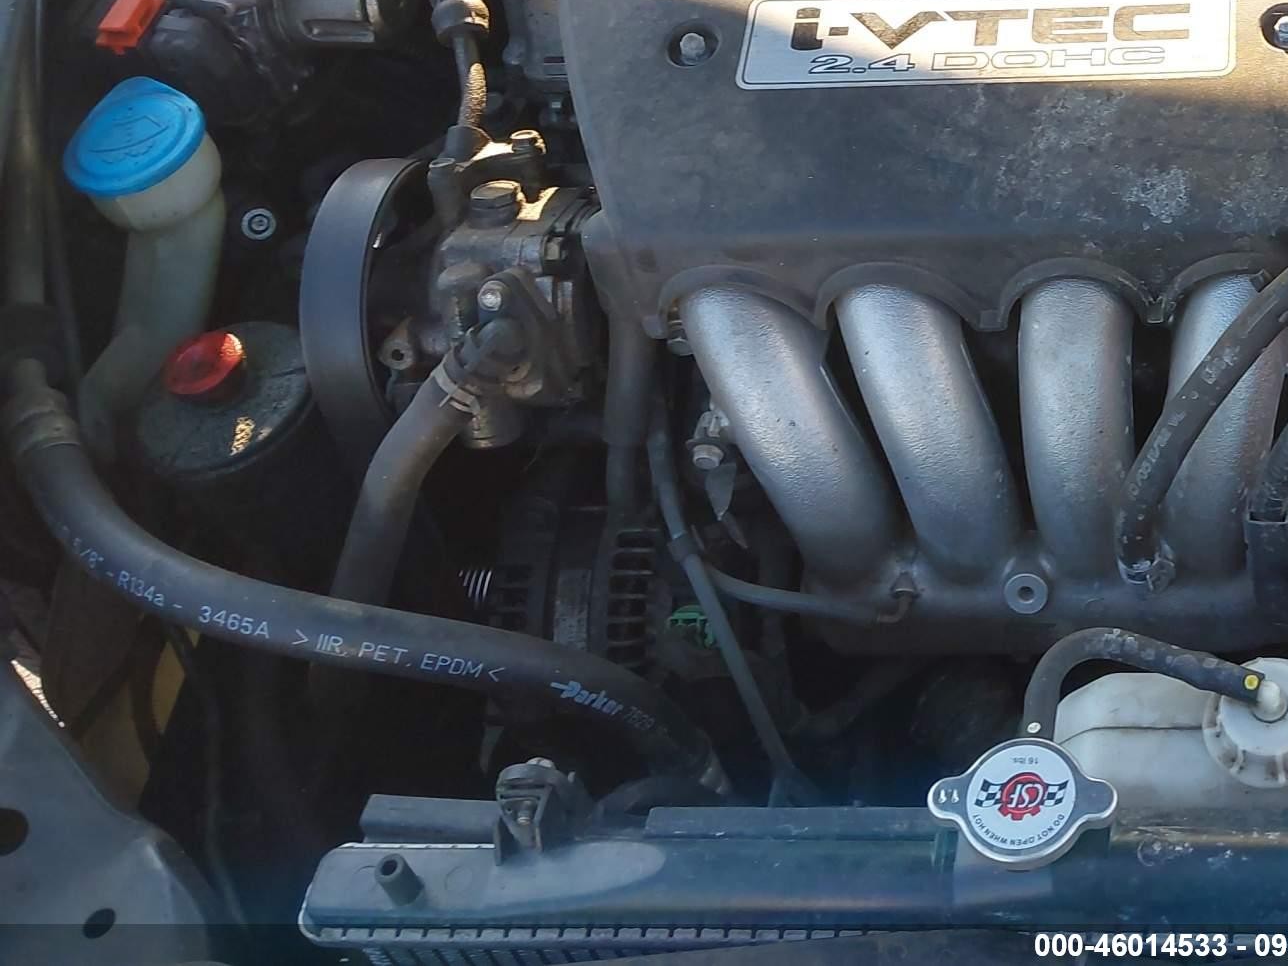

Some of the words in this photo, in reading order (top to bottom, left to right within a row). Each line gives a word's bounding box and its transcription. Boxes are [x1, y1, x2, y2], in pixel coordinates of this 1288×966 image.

[790, 3, 1190, 51] i-VTEC
[808, 52, 916, 75] 2.4
[931, 45, 1167, 71] DOHC
[117, 570, 165, 608] R134a
[199, 605, 271, 640] 3465A
[1008, 783, 1044, 809] CSF
[973, 814, 986, 830] HOT
[1053, 813, 1065, 827] DO
[984, 829, 1008, 844] WHEN
[1009, 836, 1035, 846] OPEN
[1037, 826, 1055, 840] NOT
